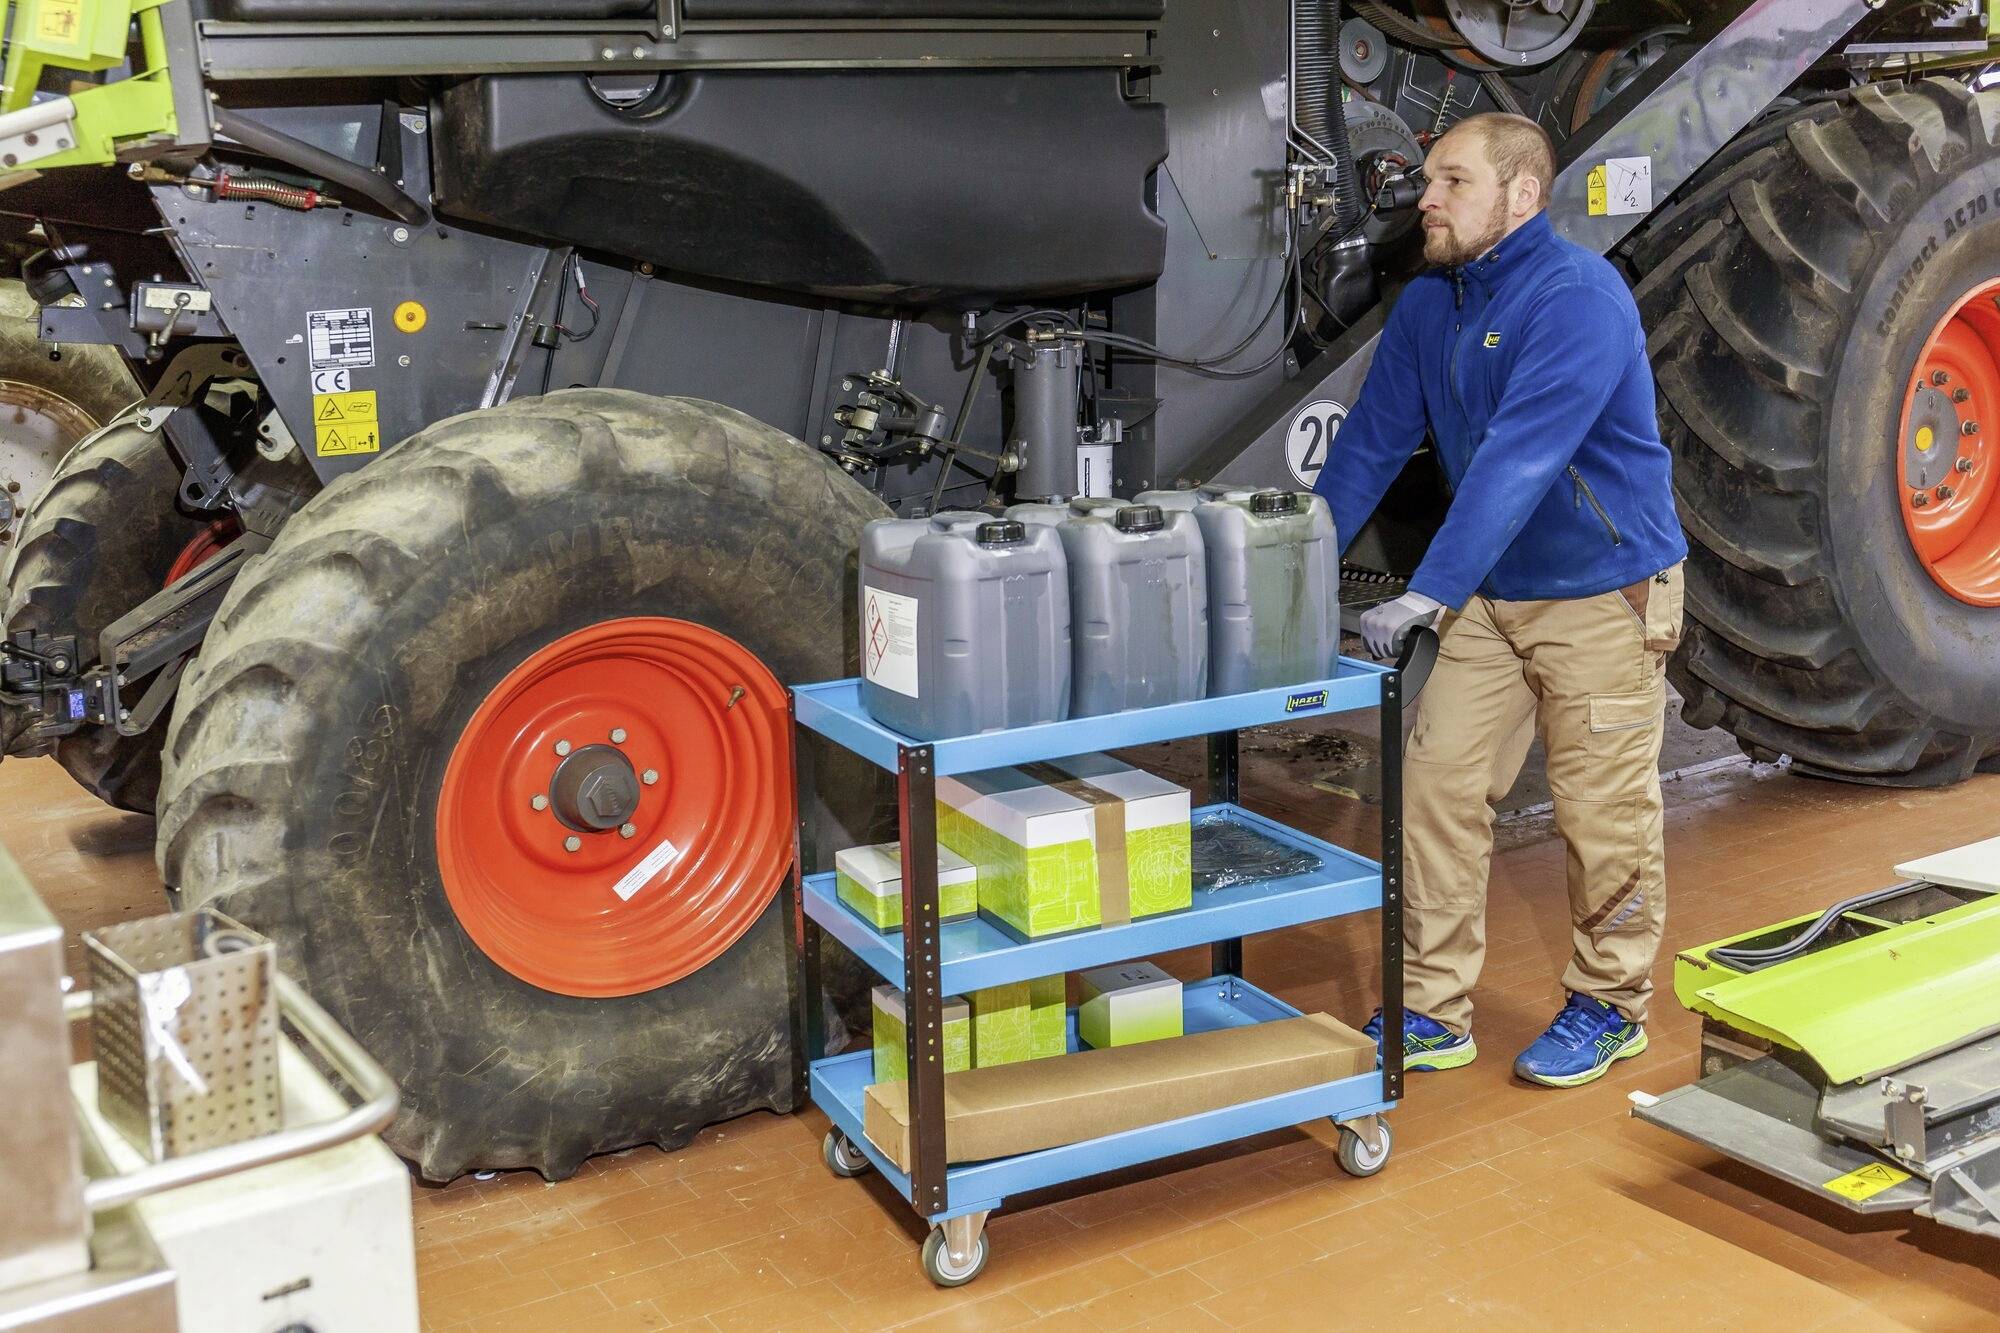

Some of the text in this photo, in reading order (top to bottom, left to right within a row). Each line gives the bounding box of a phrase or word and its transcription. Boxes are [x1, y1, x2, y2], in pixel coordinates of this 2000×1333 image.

[1643, 164, 1649, 175] 1.
[1630, 197, 1639, 207] 2.
[1291, 694, 1324, 708] HAZET
